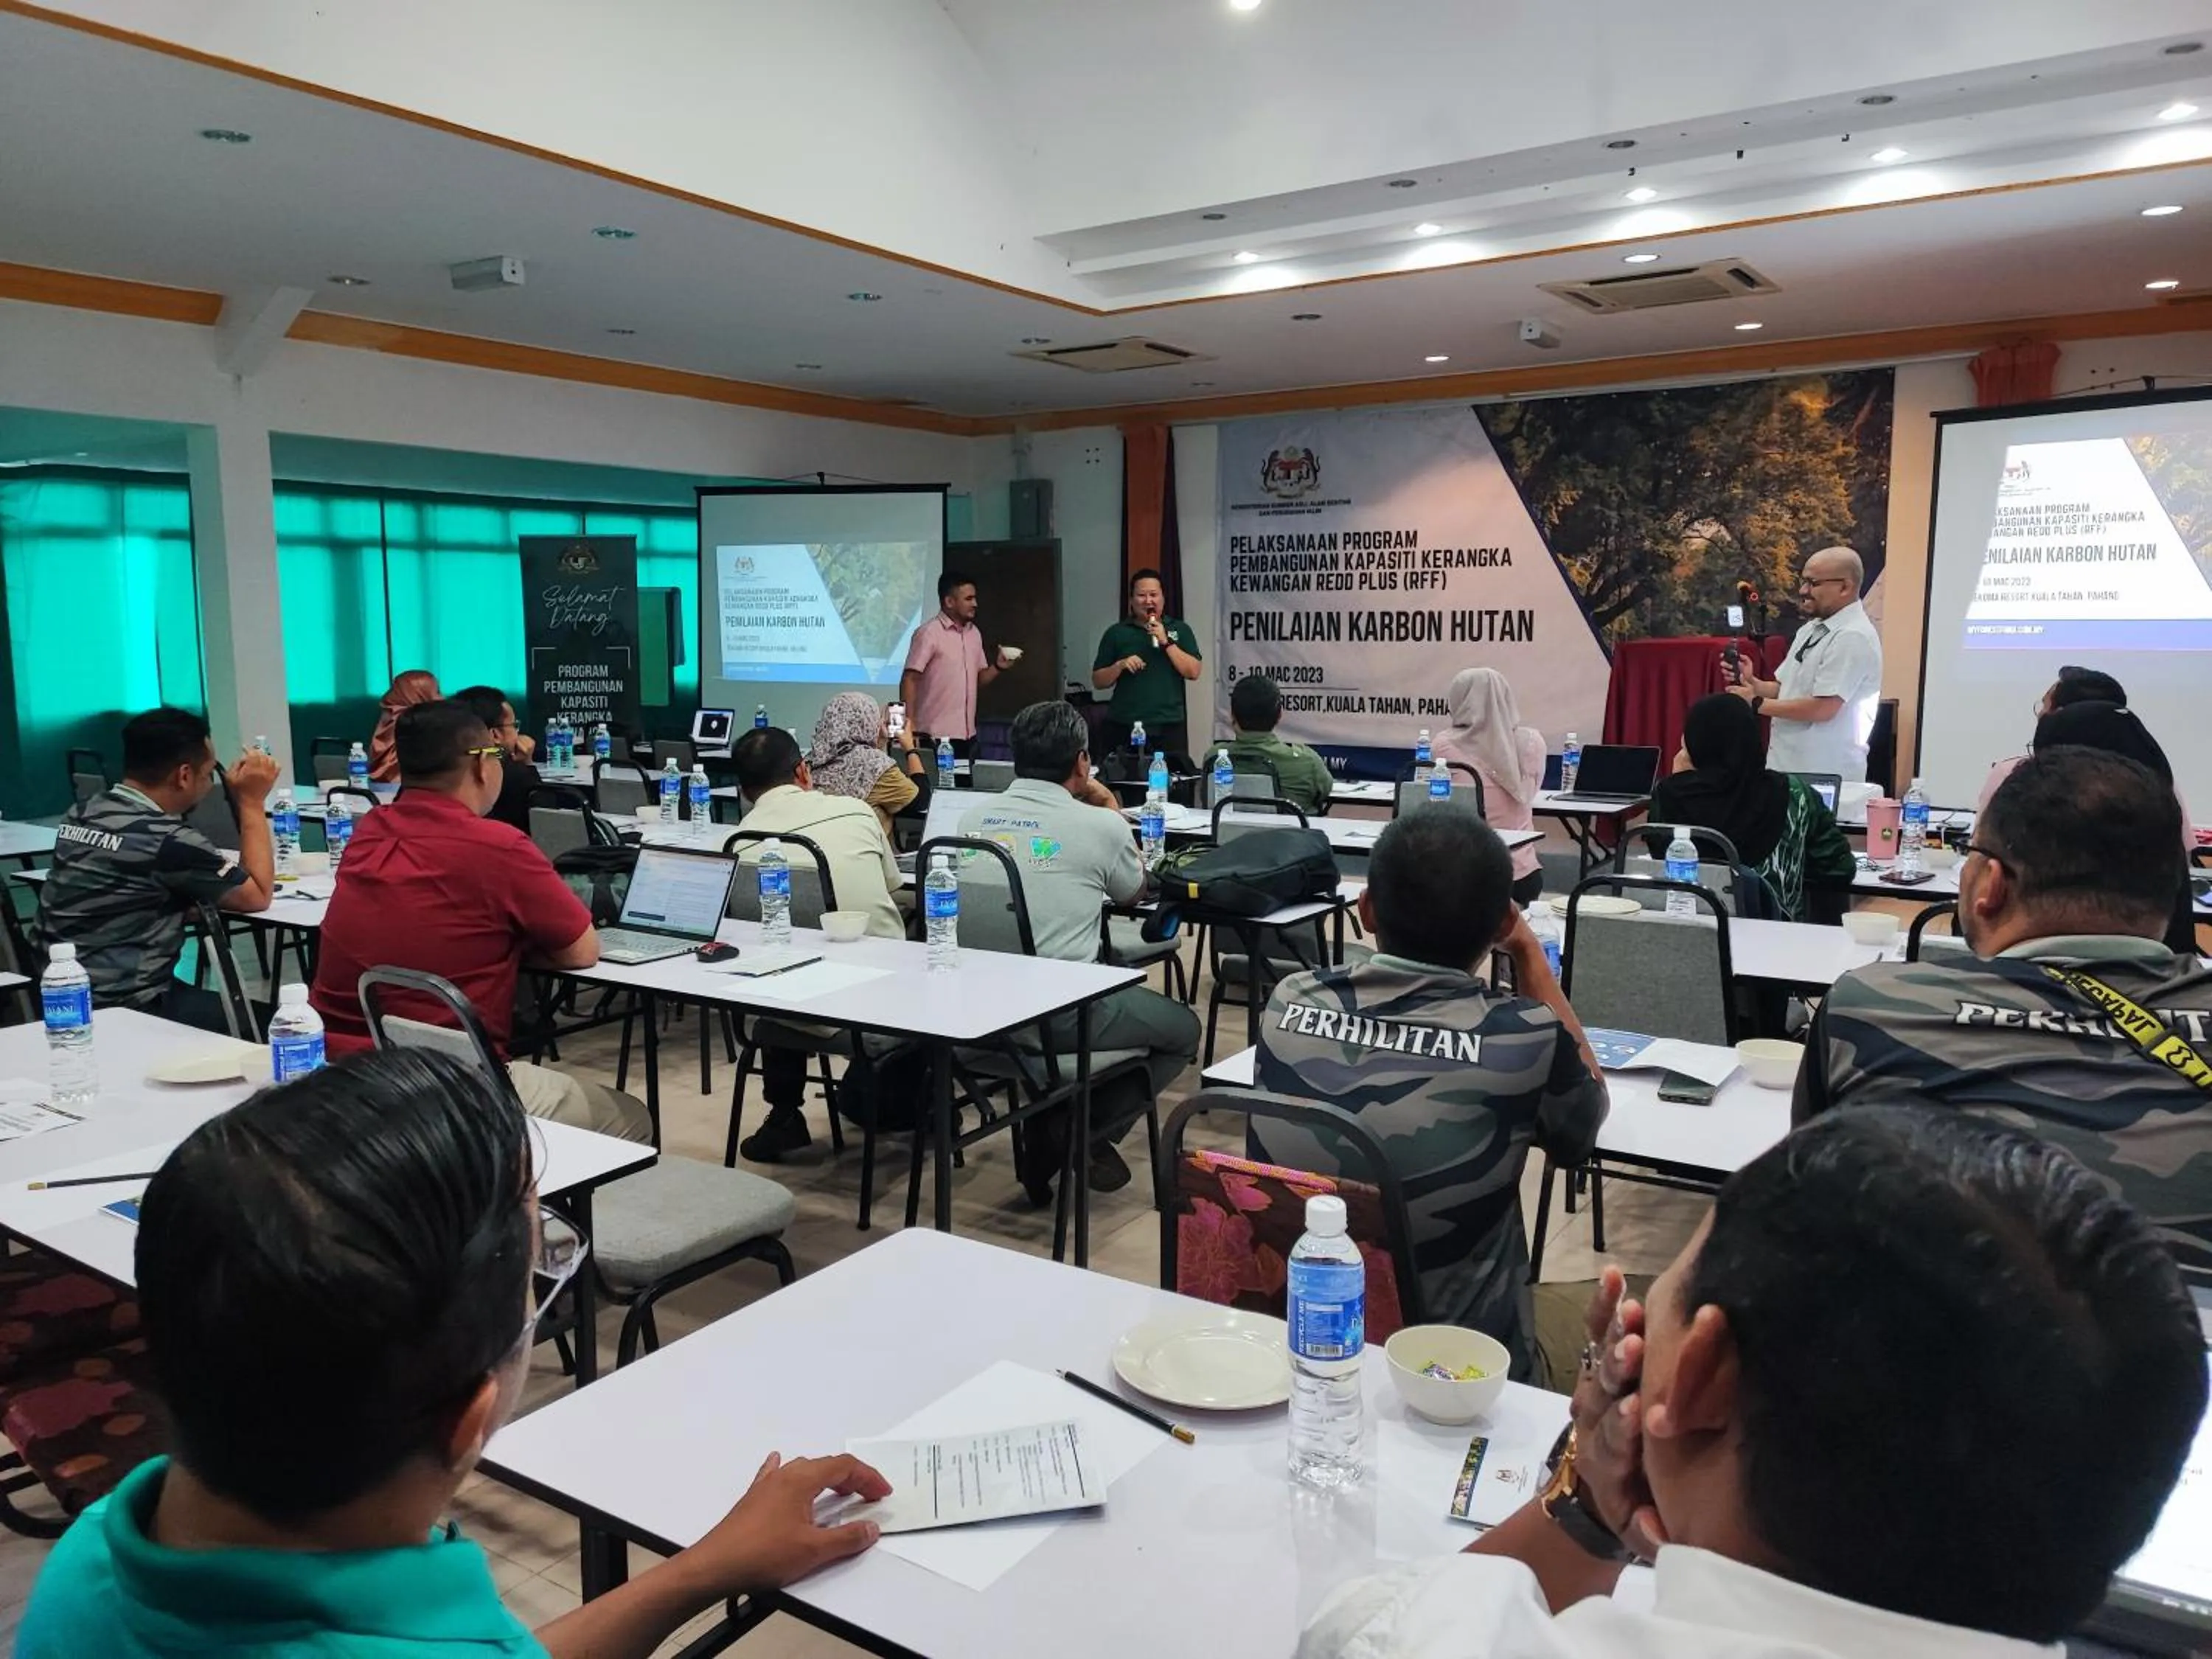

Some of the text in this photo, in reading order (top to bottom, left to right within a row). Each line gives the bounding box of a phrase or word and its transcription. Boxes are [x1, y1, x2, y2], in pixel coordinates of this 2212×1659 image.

[2045, 503, 2090, 515] PROGRAM
[2045, 514, 2090, 526] KAPASITI
[2092, 511, 2146, 523] KERANGKA
[2054, 524, 2077, 535] PLUS
[1230, 530, 1418, 554] PELAKSANAAN PROGRAM
[1230, 547, 1512, 573] PEMBANGUNAN KAPASITI KERANGKA
[2046, 545, 2103, 563] KARBON
[2108, 543, 2157, 561] HUTAN
[1230, 570, 1447, 592] KEWANGAN REDD PLUS (RFF)
[1230, 609, 1534, 643] PENILAIAN KARBON HUTAN
[558, 664, 608, 678] PROGRAM
[1229, 666, 1236, 681] 8
[1265, 667, 1291, 682] MAC
[1293, 667, 1324, 684] 2023
[543, 680, 623, 693] PEMBANGUNAN
[561, 696, 608, 709] KAPASITI
[1369, 697, 1414, 716] TAHAN,
[1279, 1003, 1481, 1063] PERHILITAN
